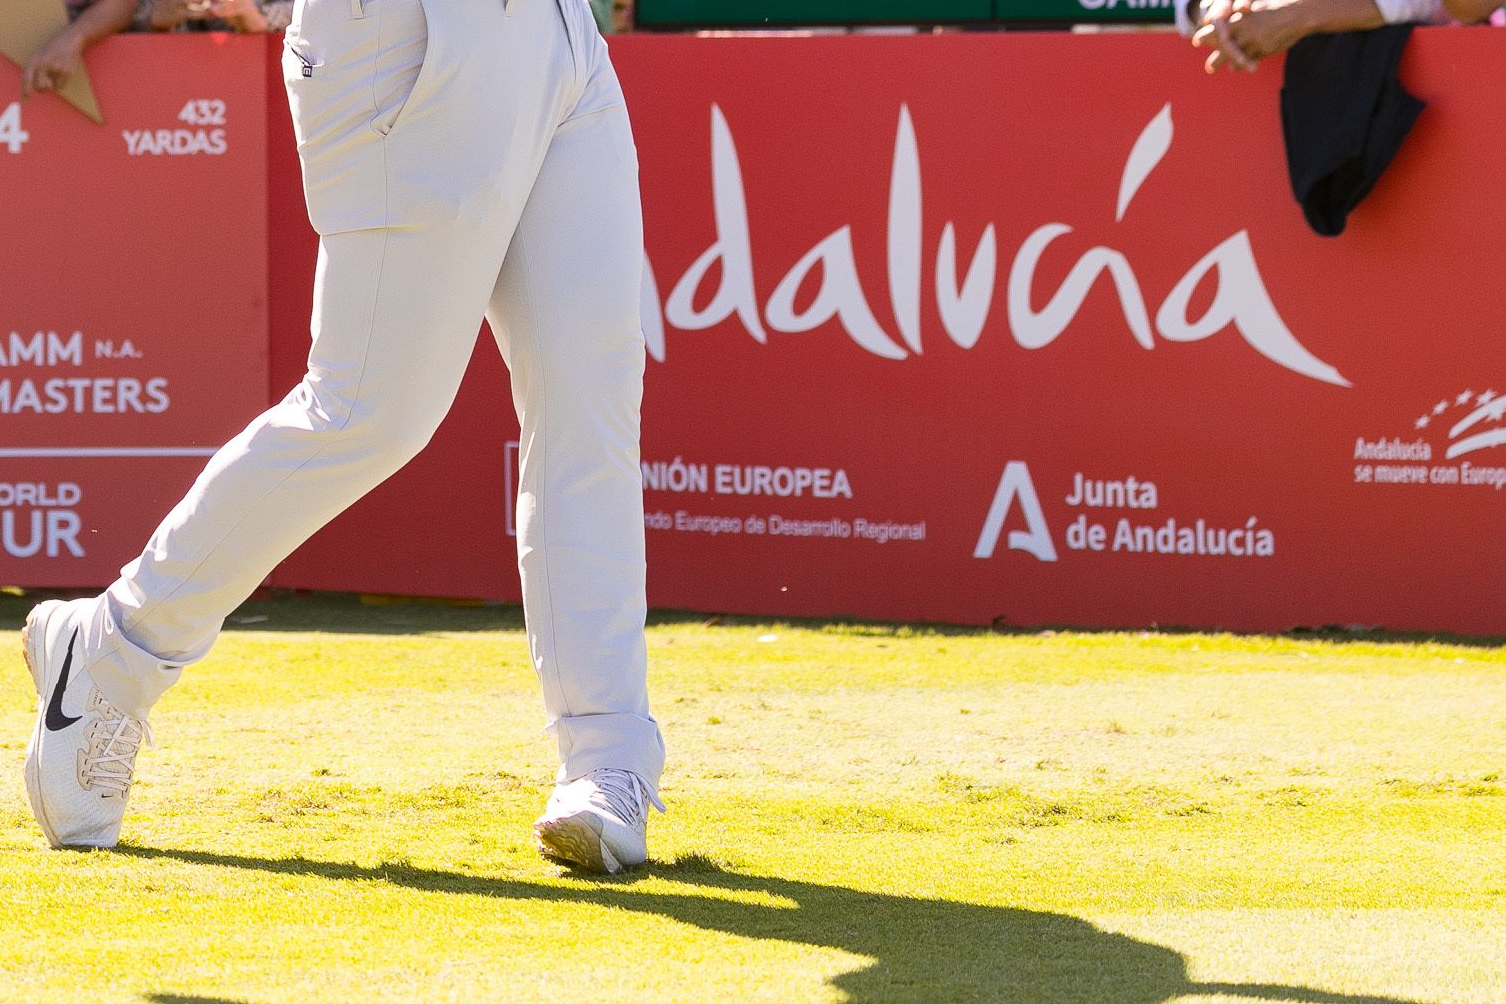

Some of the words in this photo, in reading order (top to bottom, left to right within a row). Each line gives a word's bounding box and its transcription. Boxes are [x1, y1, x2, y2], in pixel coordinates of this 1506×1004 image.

[177, 98, 227, 126] 432
[121, 128, 228, 156] YARDAS
[640, 101, 1353, 388] dalucía
[94, 339, 143, 358] N.A.
[641, 456, 708, 492] NIÓN
[714, 463, 854, 499] EUROPEA
[1064, 472, 1158, 509] Junta
[1460, 461, 1506, 491] Europ
[645, 511, 673, 530] ndo
[674, 510, 742, 536] Europeo
[743, 515, 766, 535] de
[768, 514, 852, 538] Desarrollo
[853, 517, 926, 544] Regional
[1065, 513, 1107, 551] de
[1111, 515, 1275, 557] Andalucía
